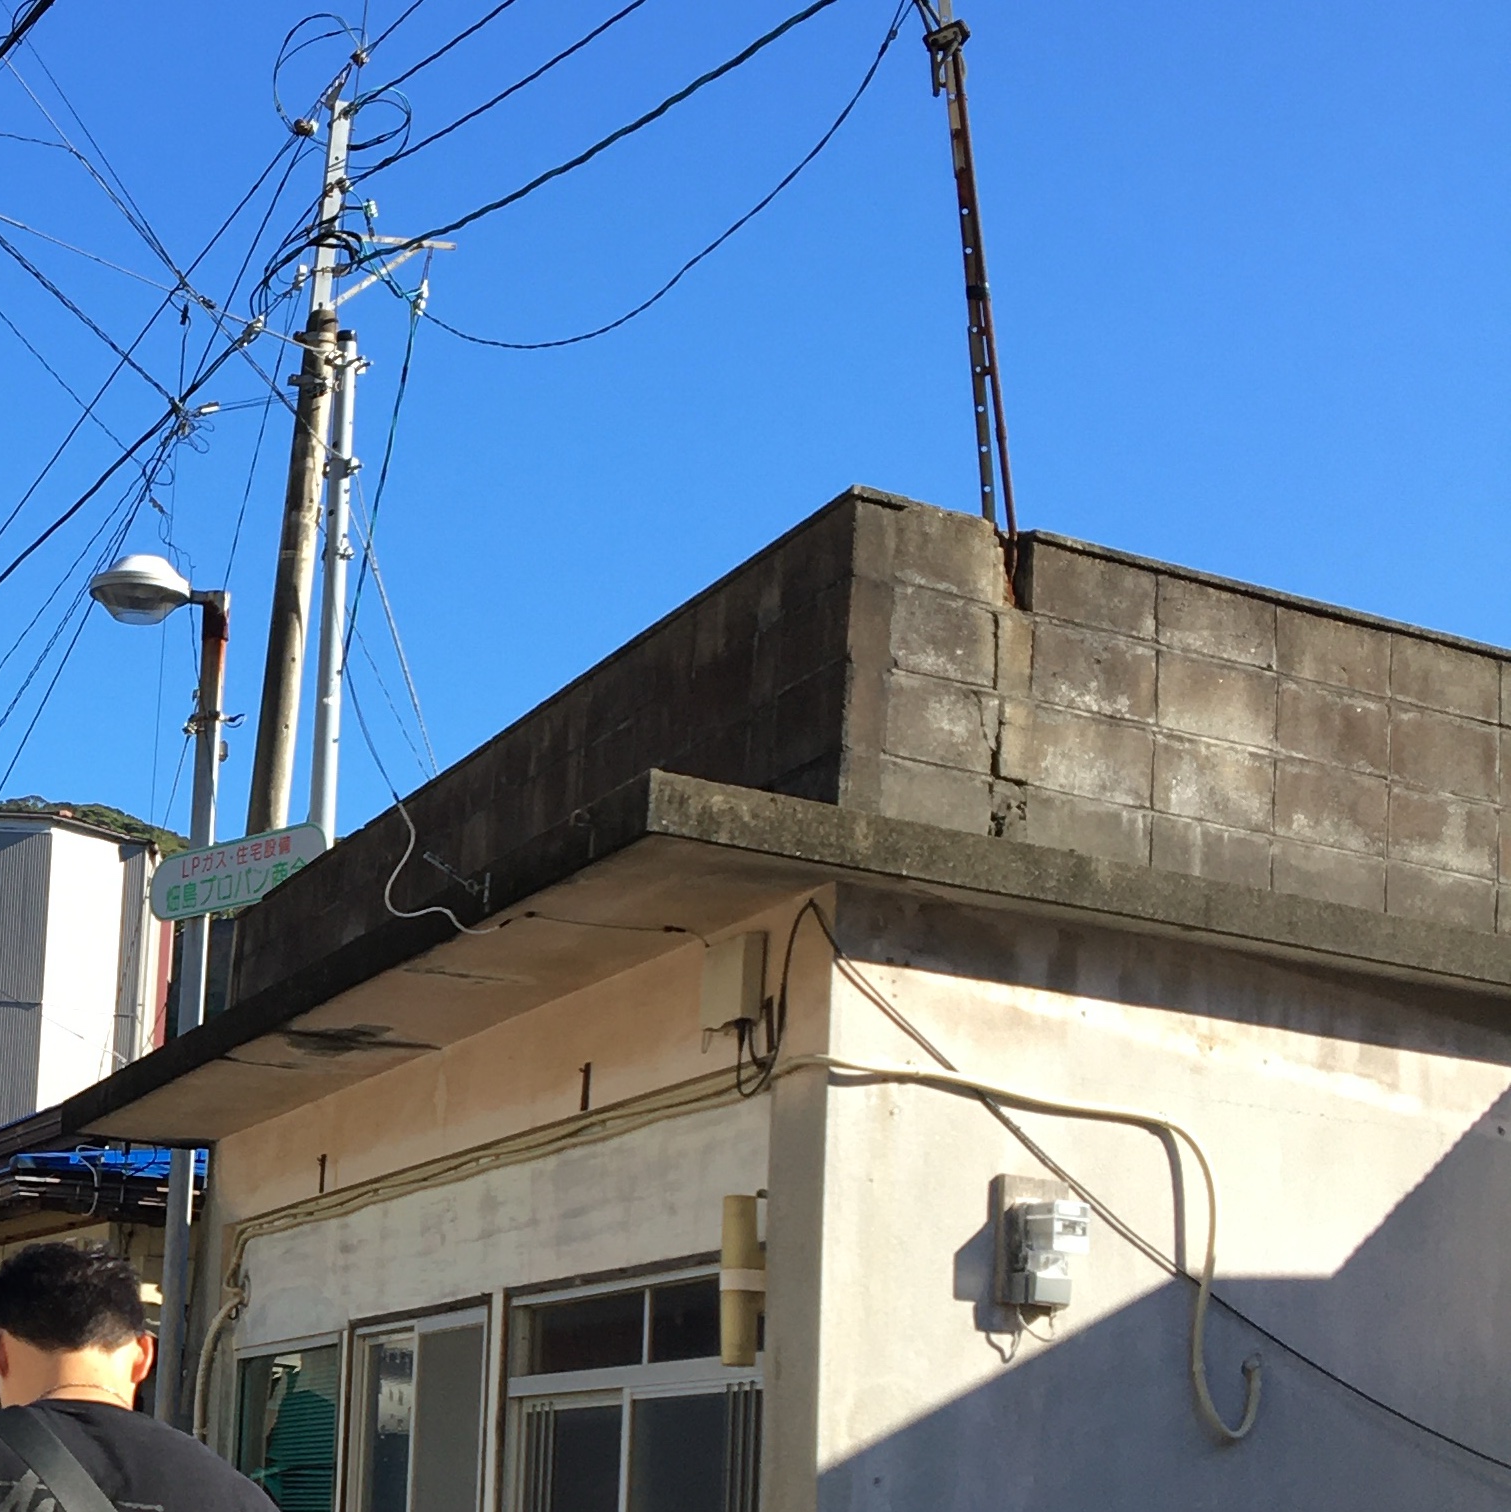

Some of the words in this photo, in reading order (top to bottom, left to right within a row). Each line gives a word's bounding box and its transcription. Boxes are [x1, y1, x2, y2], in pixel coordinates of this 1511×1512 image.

[181, 835, 292, 879] LPガス・住宅設備
